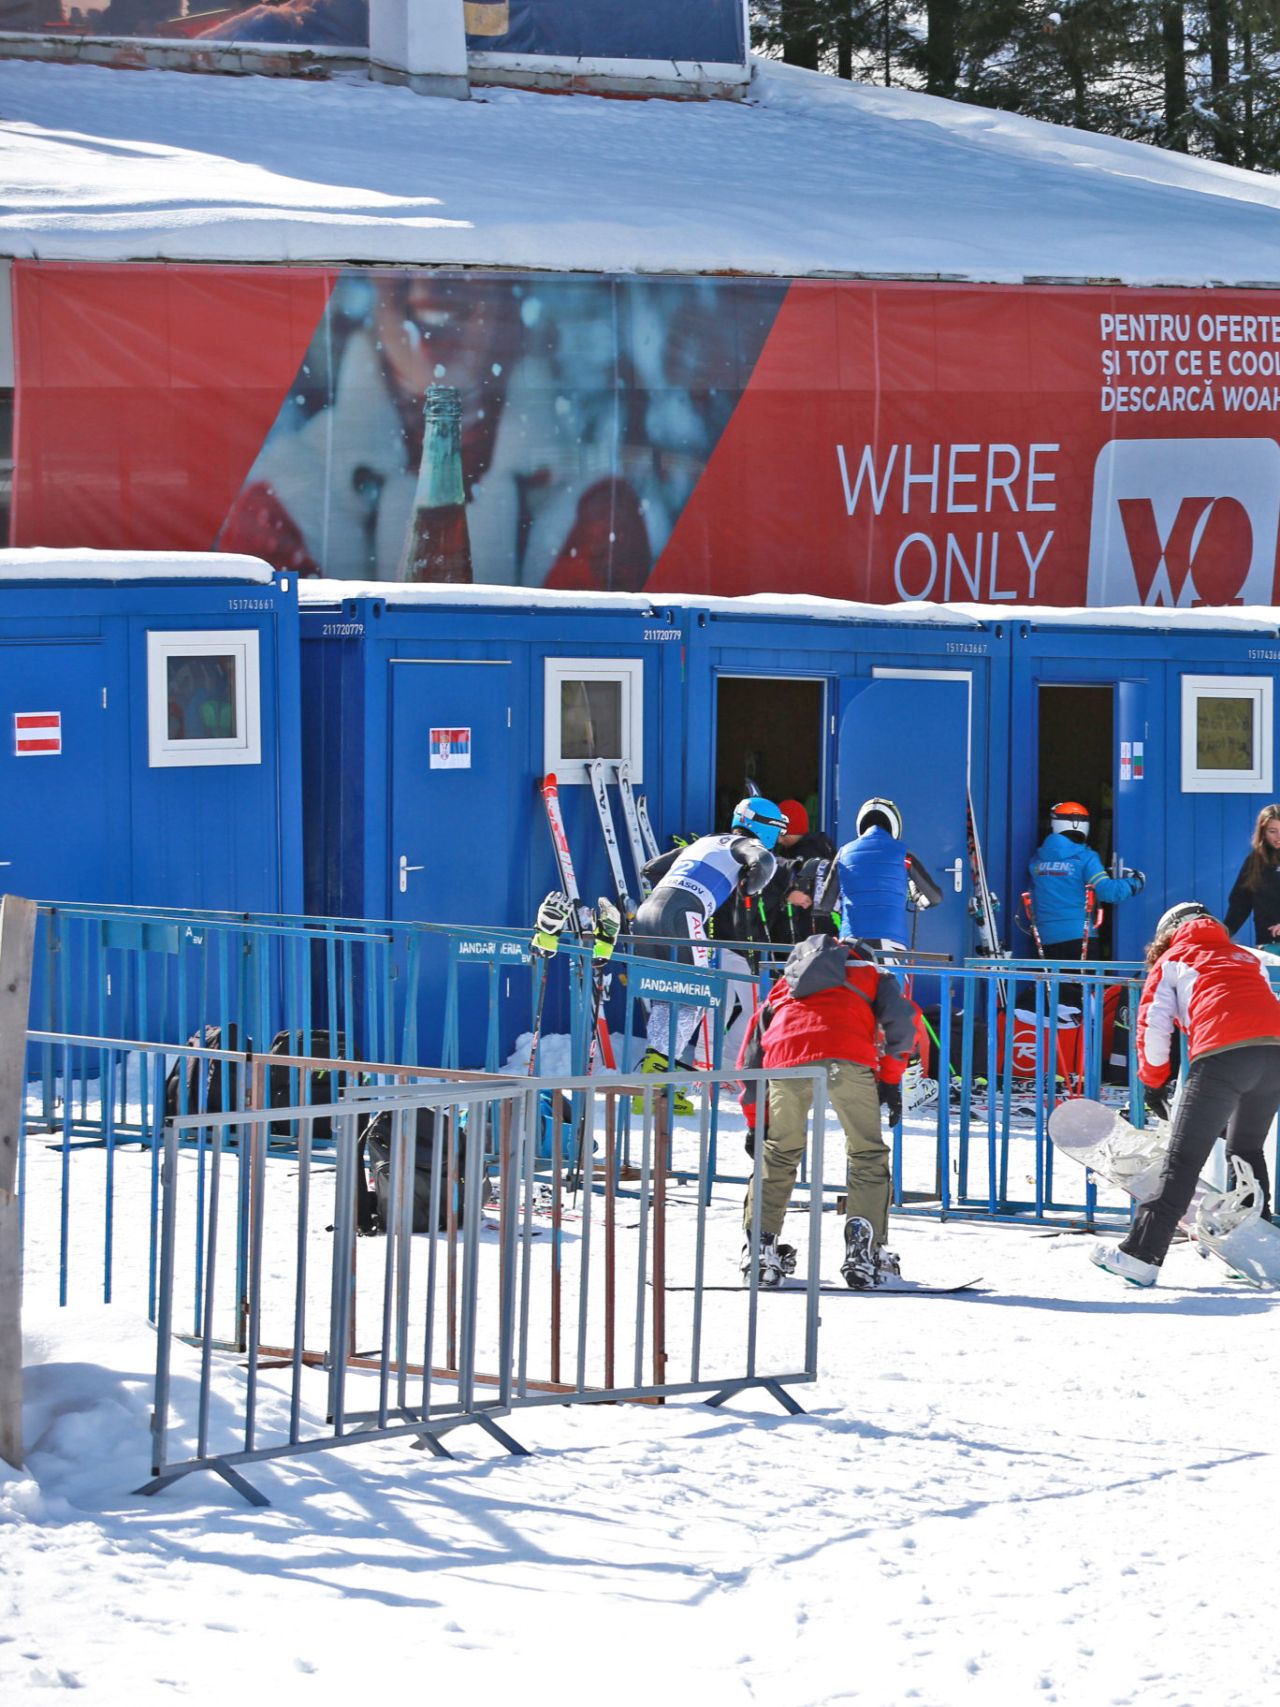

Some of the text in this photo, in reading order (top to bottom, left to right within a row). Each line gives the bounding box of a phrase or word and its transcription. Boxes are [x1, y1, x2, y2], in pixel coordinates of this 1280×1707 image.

[1100, 313, 1190, 342] PENTRU
[1126, 350, 1169, 376] TOT
[1174, 350, 1203, 376] CE
[1208, 351, 1222, 376] E
[1101, 379, 1216, 412] DESCARCĂ
[836, 444, 1060, 516] WHERE
[894, 530, 1055, 602] ONLY
[228, 599, 274, 610] 151743661
[322, 624, 364, 635] 211720779
[643, 629, 682, 641] 211720779
[458, 942, 522, 955] JANDARERIA
[639, 977, 711, 998] JANDARMERIA
[709, 997, 721, 1007] BV
[907, 1087, 939, 1112] HEAD
